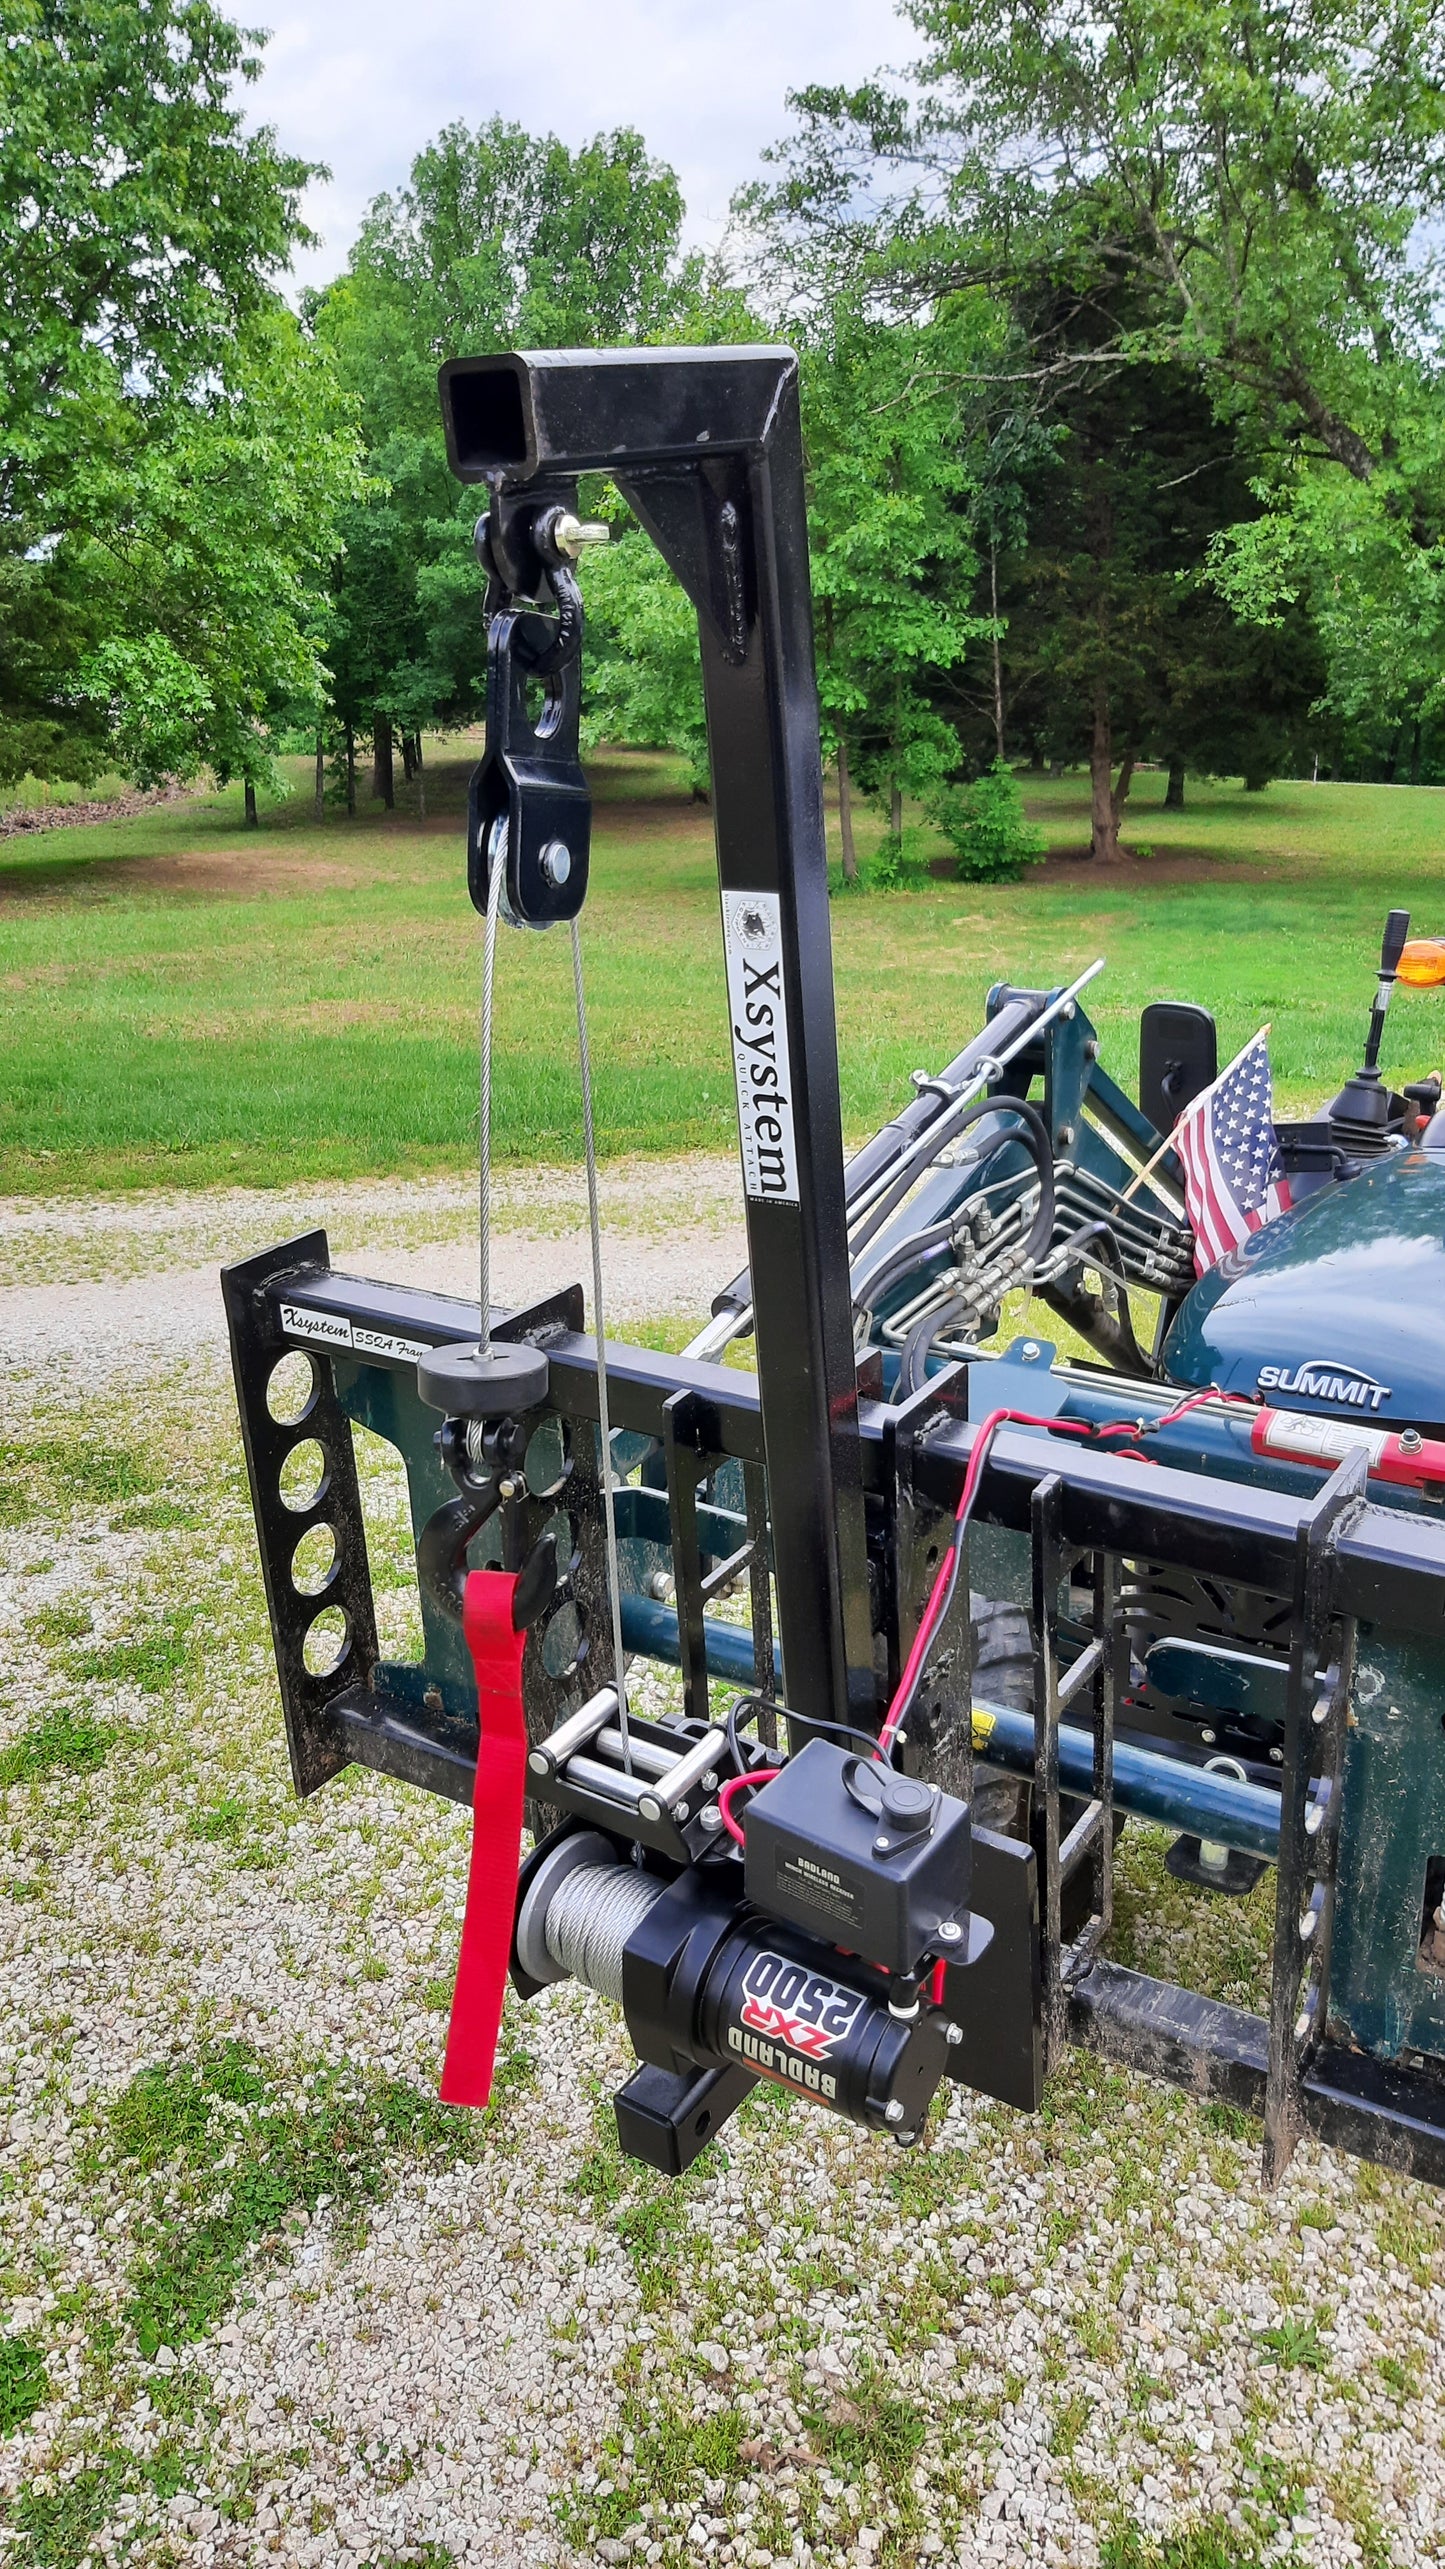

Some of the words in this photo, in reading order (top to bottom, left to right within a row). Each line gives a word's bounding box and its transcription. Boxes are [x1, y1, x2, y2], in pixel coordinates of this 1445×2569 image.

[735, 958, 788, 1194] Xsystem
[737, 1053, 749, 1109] QUICK
[743, 1123, 757, 1190] ATTACH
[283, 1308, 350, 1338] Xsystem
[1257, 1361, 1392, 1410] SUMMIT
[797, 1857, 840, 1885] BADLAND
[742, 1997, 832, 2059] ZXR
[744, 1953, 865, 2038] 2500
[728, 2026, 837, 2100] BADLAND
